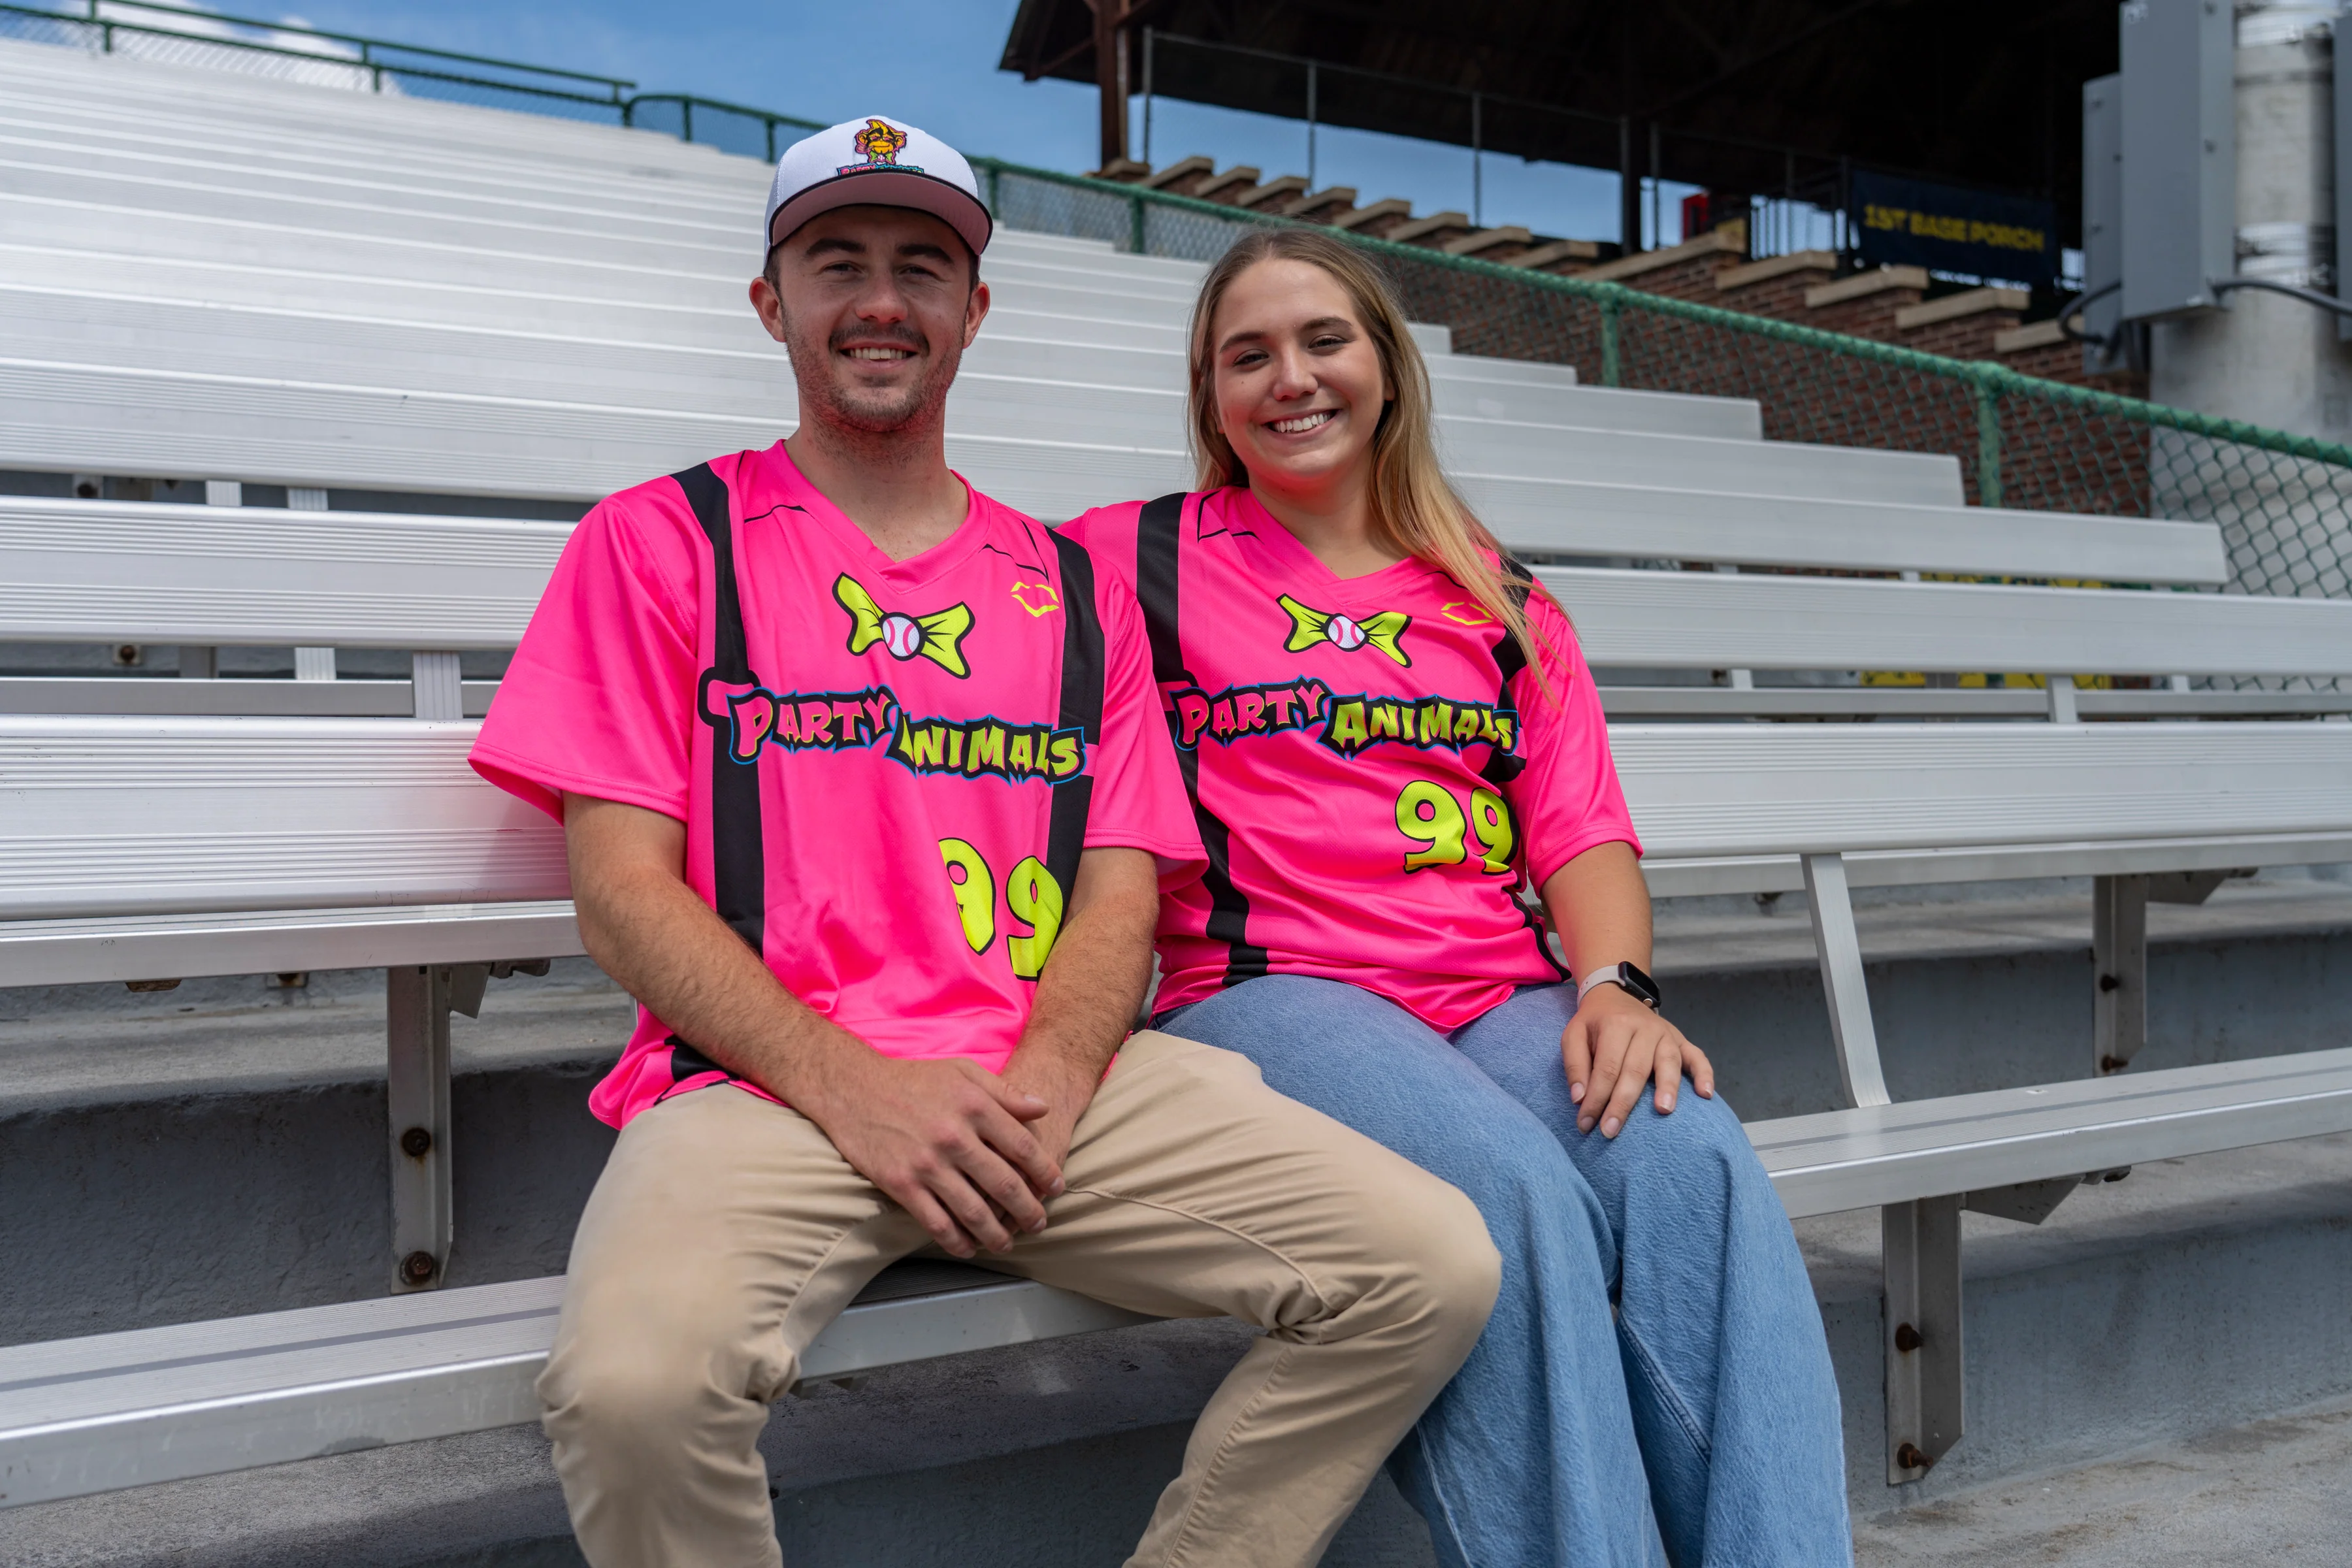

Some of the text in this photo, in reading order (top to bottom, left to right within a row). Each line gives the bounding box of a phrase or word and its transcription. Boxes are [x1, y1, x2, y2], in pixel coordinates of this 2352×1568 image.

[1864, 203, 2044, 252] 1ST BASE PORCH
[732, 688, 892, 758] PARTY
[1177, 683, 1513, 749] PARTY ANIMALS
[1395, 779, 1521, 875] 99
[938, 838, 1064, 981] 99
